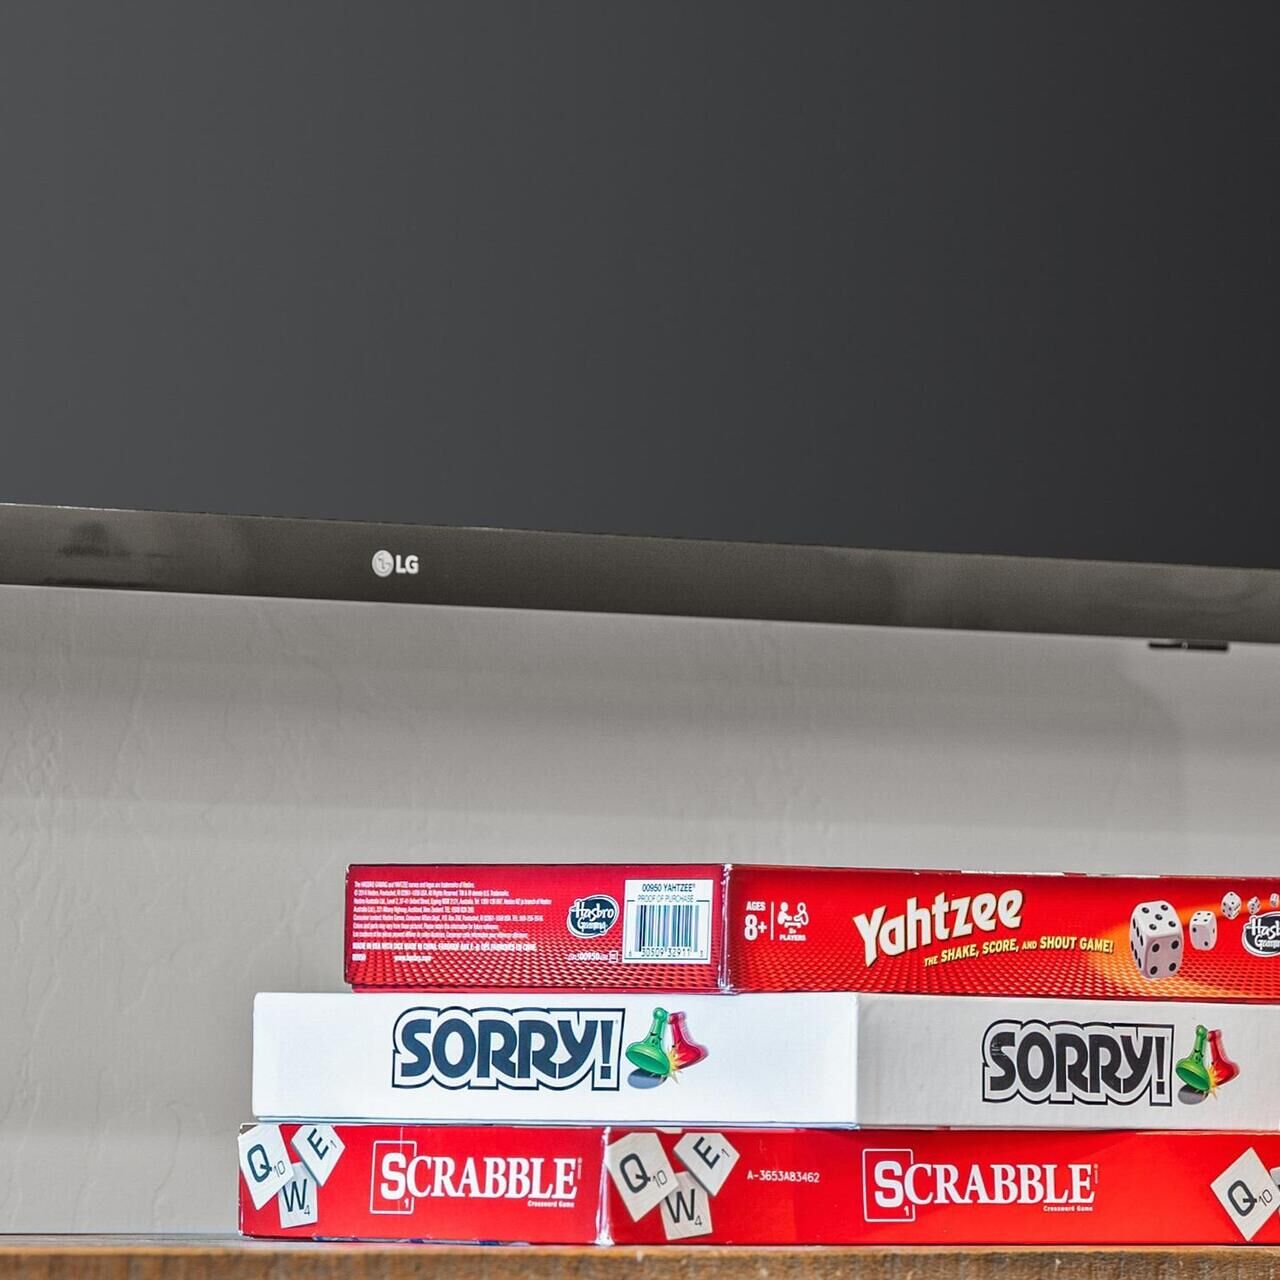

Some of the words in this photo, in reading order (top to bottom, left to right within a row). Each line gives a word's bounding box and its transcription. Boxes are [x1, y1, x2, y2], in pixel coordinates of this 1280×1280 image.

[395, 554, 419, 574] LG
[570, 901, 615, 921] Hasbro
[746, 901, 766, 911] AGES
[744, 914, 767, 941] 8+
[853, 889, 1023, 967] Yahtzee
[924, 956, 938, 967] THE
[941, 944, 979, 963] SHAKE,
[982, 939, 1019, 955] SCORE,
[1022, 940, 1037, 950] AND
[1040, 936, 1077, 950] SHOUT
[1080, 937, 1114, 953] GAME!
[401, 1018, 614, 1080] SORRY!
[990, 1031, 1166, 1095] SORRY!
[307, 1128, 329, 1160] E
[693, 1136, 720, 1169] E
[247, 1144, 272, 1183] Q
[381, 1152, 578, 1200] SCRABBLE
[619, 1153, 651, 1193] Q
[282, 1179, 307, 1212] W
[874, 1160, 1096, 1208] SCRABBLE
[1227, 1180, 1258, 1217] Q
[665, 1189, 696, 1223] W
